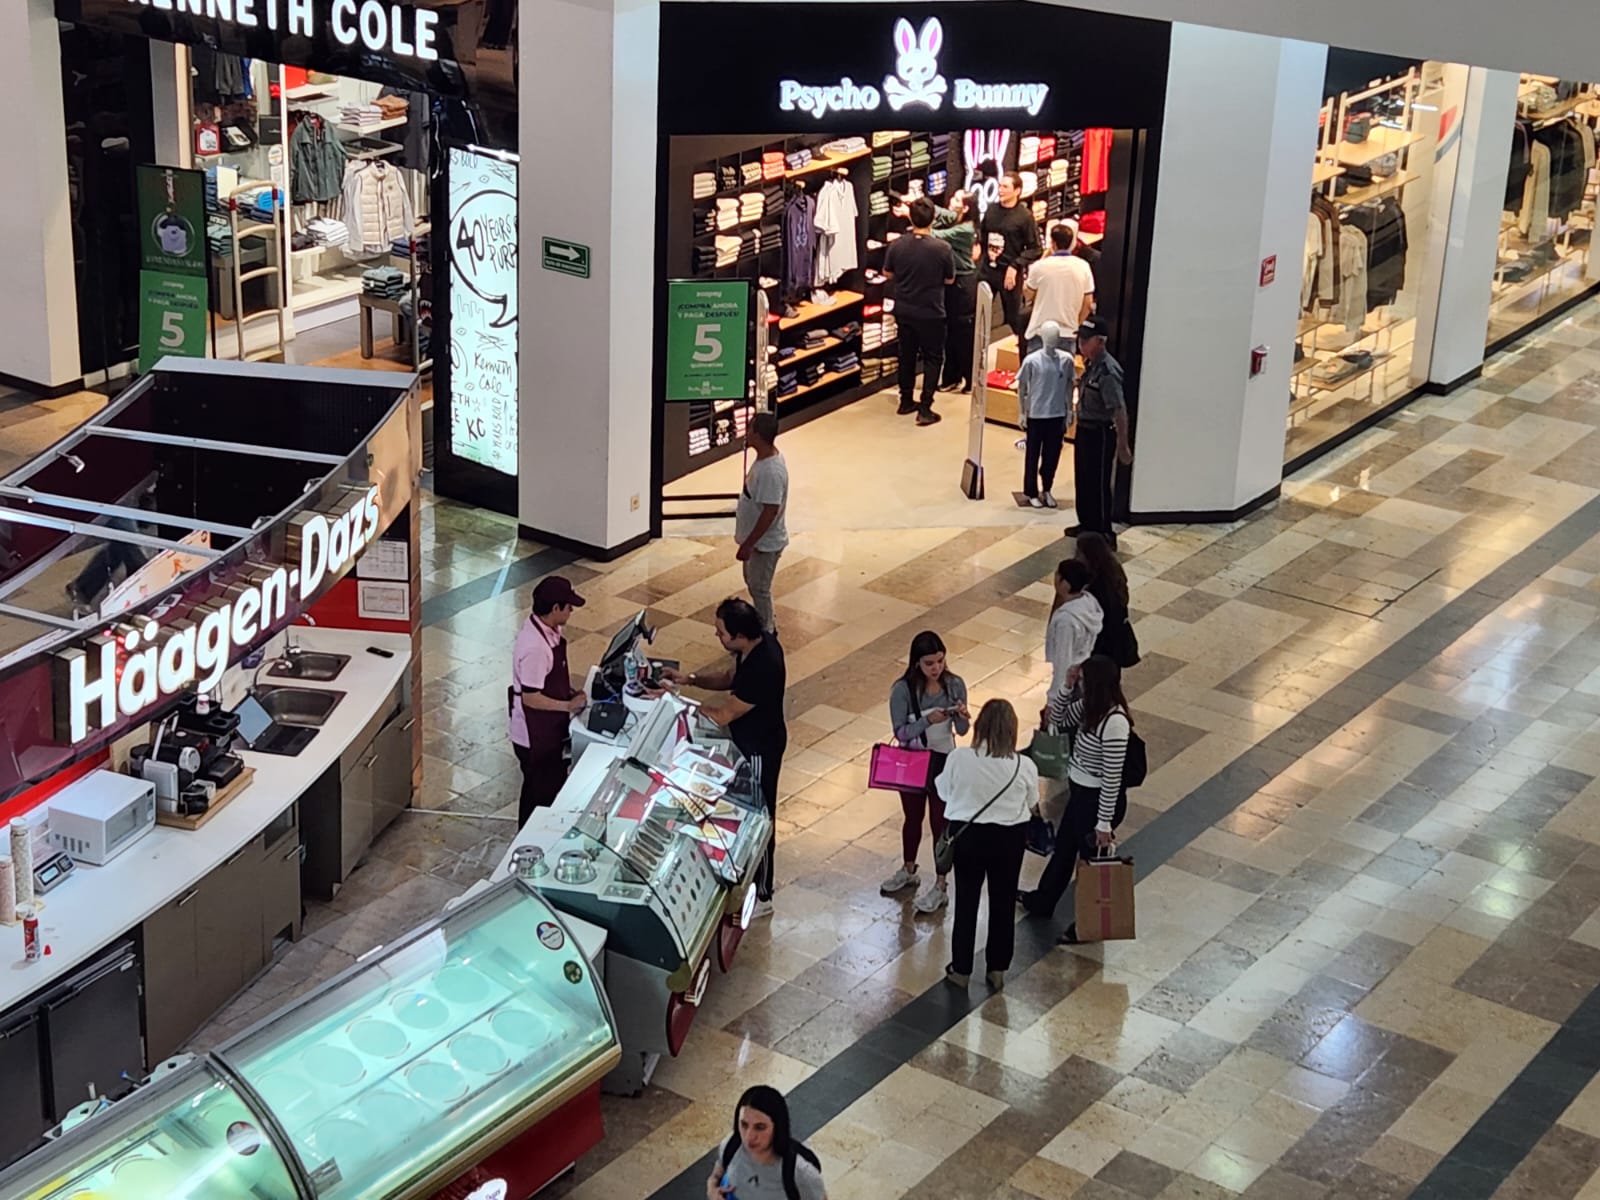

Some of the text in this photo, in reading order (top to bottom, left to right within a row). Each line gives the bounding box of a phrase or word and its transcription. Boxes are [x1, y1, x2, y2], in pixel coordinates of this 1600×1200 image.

[128, 0, 439, 60] NETH COLE
[778, 77, 1050, 119] Psycho Bunny
[159, 311, 185, 347] 5
[692, 323, 723, 362] 5
[70, 484, 379, 744] Häagen-Dazs
